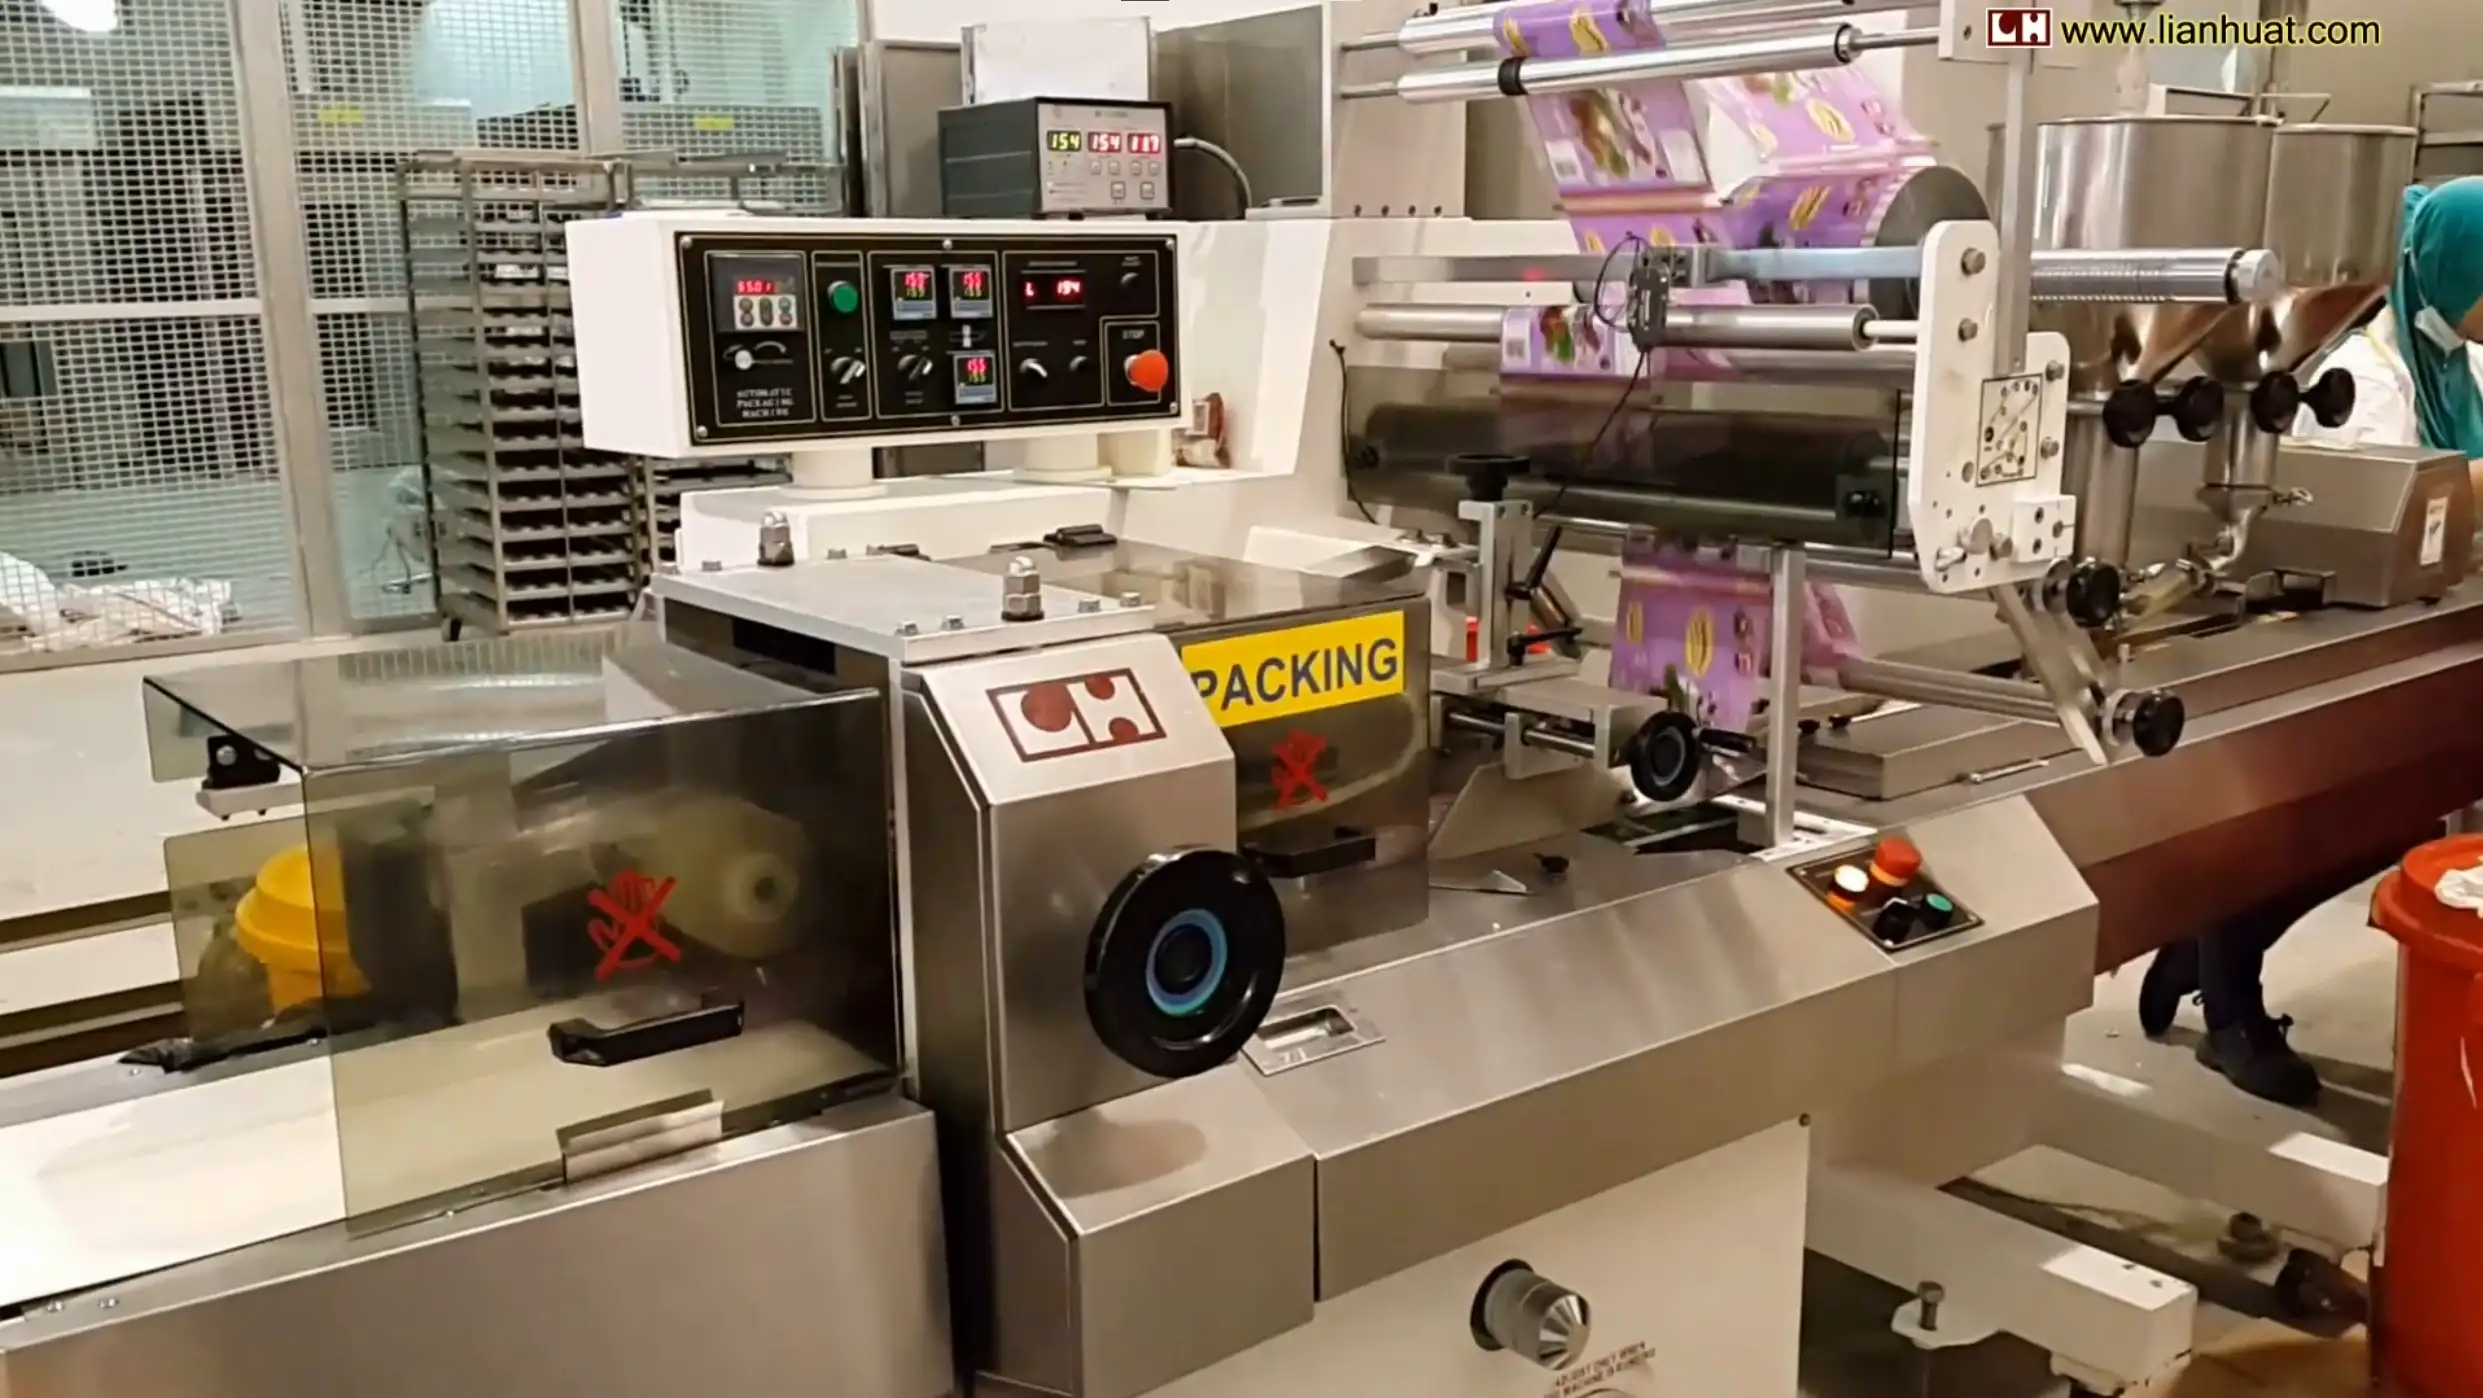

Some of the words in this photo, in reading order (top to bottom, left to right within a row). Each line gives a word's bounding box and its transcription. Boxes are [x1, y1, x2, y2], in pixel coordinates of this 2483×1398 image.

[1051, 133, 1080, 149] 154
[1092, 134, 1120, 150] 154
[1122, 329, 1145, 340] STOP
[736, 387, 792, 398] AUTOMATIC
[742, 408, 790, 418] MACHINE
[1191, 637, 1399, 712] PACKING
